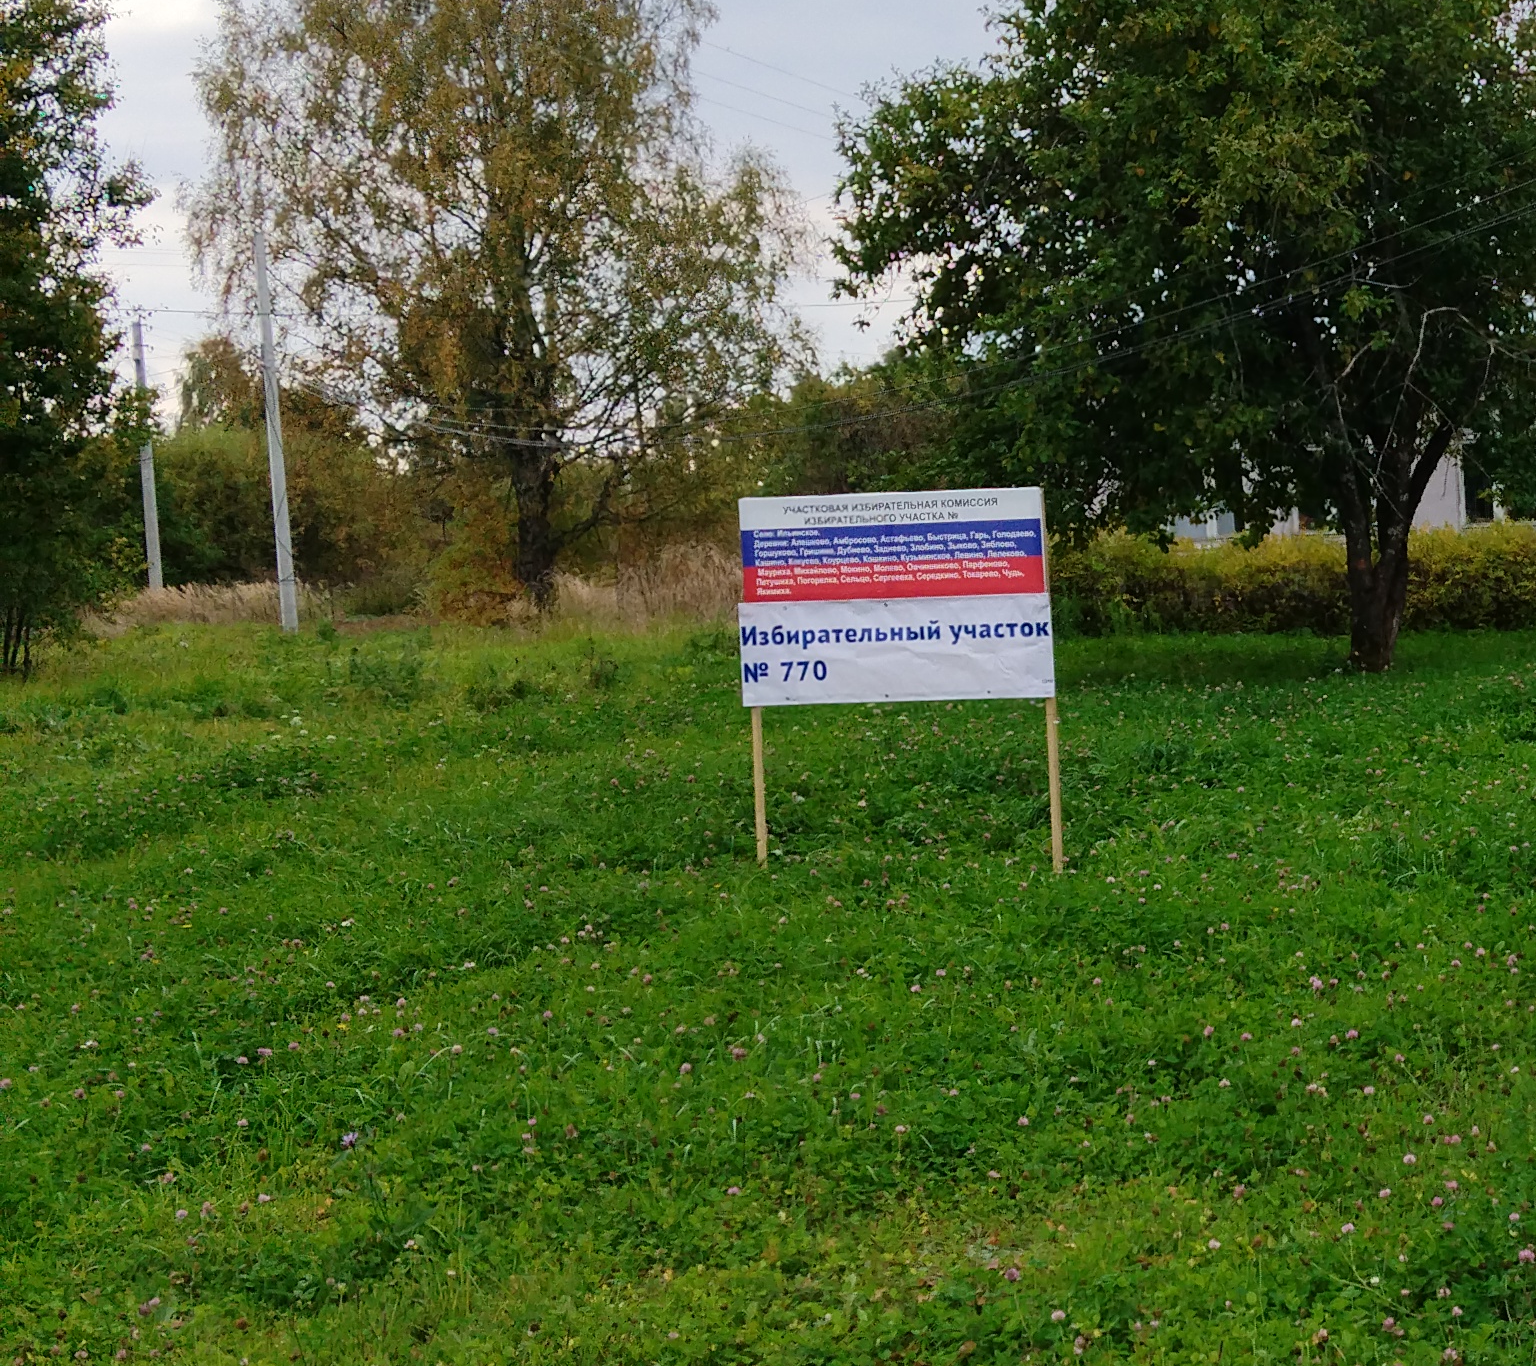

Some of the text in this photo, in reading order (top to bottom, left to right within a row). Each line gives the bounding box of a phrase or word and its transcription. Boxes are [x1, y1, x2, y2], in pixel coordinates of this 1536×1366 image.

[783, 497, 998, 515] УЧАСТКОВАЯ ИЗБИРАТЕЛЬНАЯ КОМИССИЯ
[804, 511, 959, 525] ИЗБИРАТЕЛЬНОГО УЧАСТКА №
[740, 620, 1050, 650] Избирательный участок
[743, 660, 827, 683] № 770
